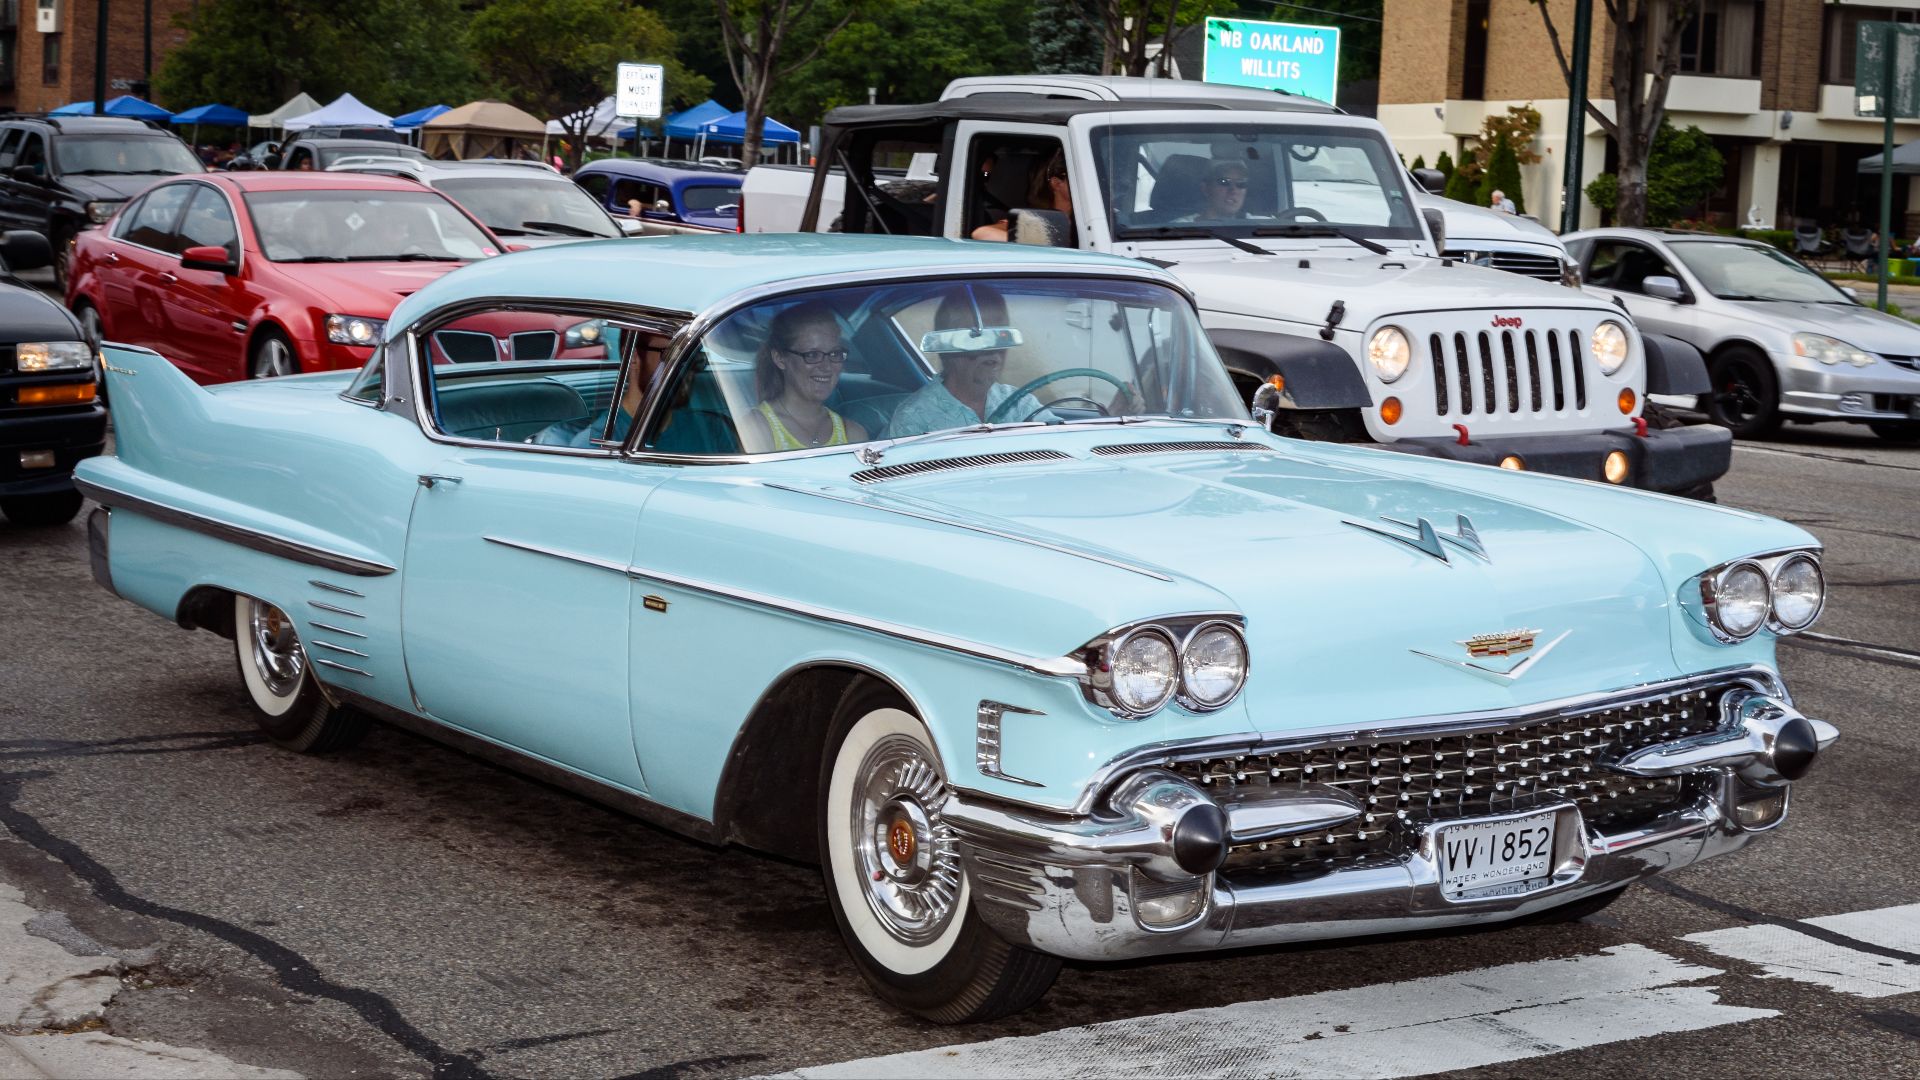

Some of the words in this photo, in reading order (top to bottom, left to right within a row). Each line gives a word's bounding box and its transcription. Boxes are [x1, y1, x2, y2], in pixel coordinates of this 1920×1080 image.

[1220, 31, 1242, 48] WB
[1250, 32, 1324, 55] OAKLAND
[1241, 57, 1300, 79] WILLITS
[628, 85, 651, 96] MUST
[1491, 314, 1522, 329] Jeep
[1445, 873, 1476, 886] WATER
[1483, 861, 1545, 879] WONDERLAND
